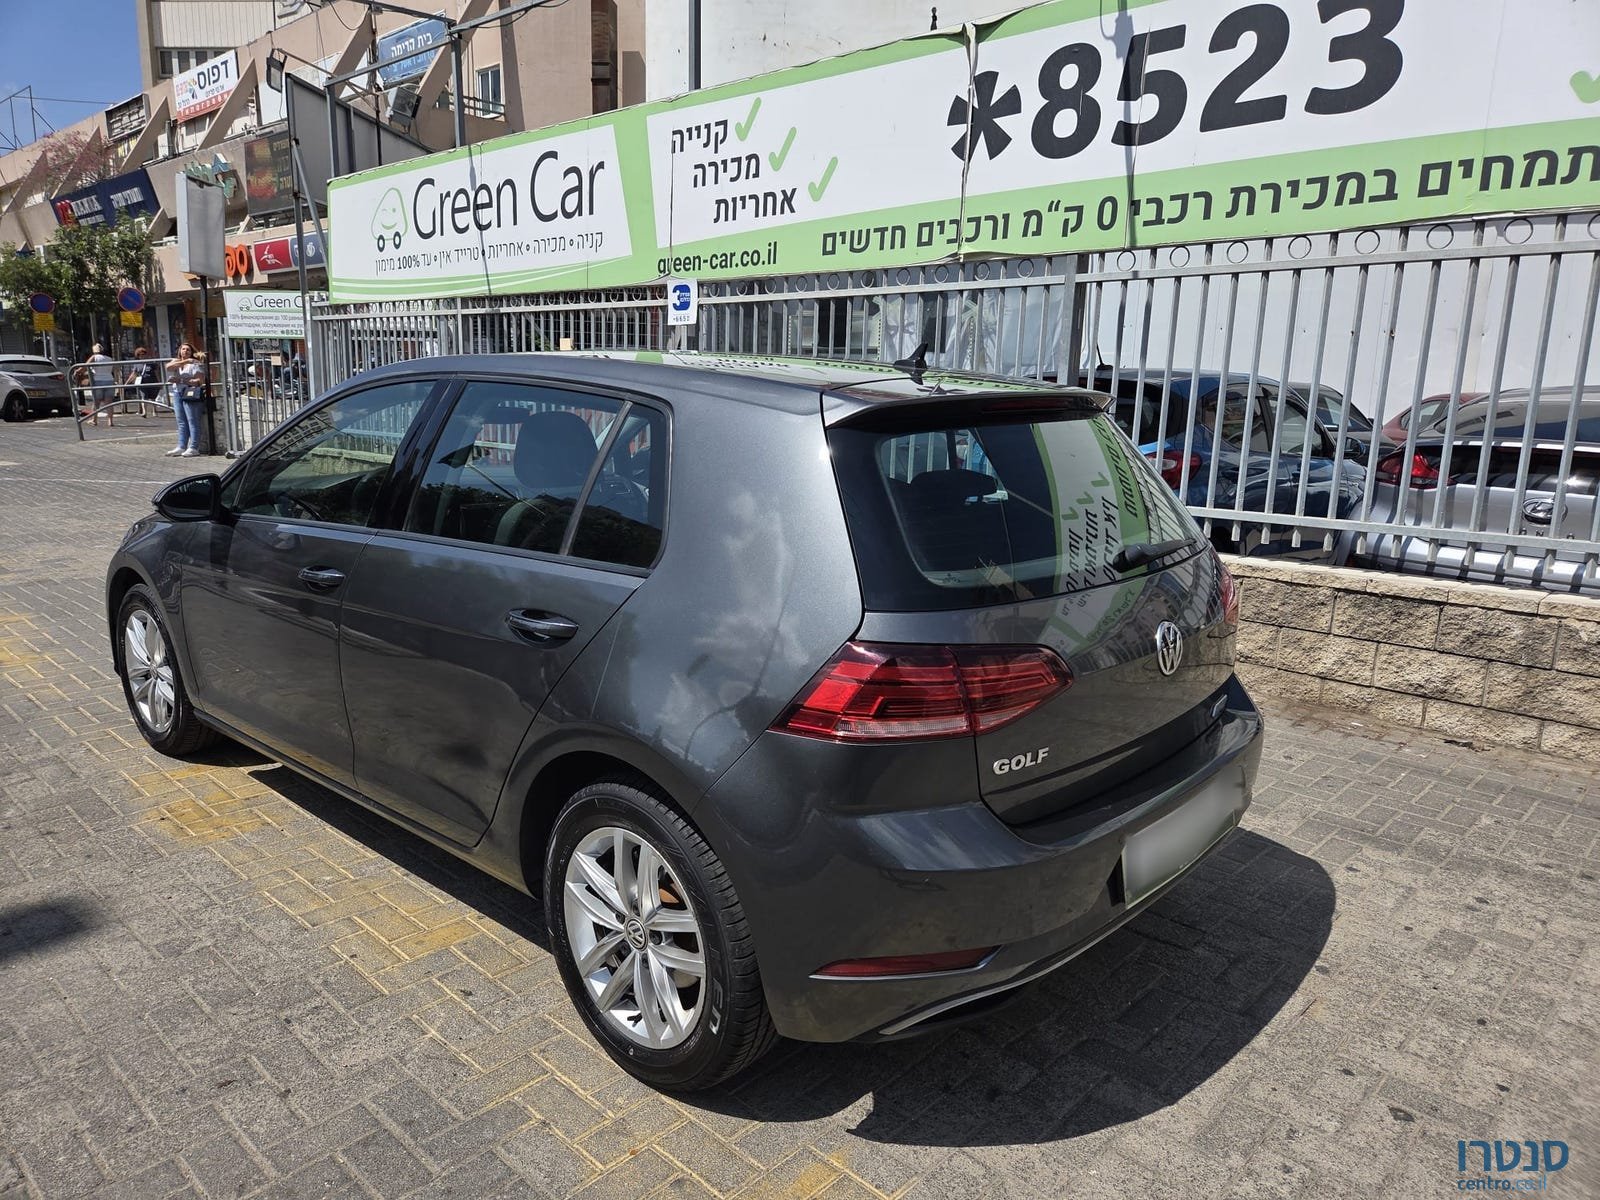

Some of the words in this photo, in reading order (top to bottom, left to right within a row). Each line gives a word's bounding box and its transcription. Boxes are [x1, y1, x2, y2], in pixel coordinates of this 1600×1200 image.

[197, 60, 229, 90] דפוס
[671, 119, 729, 154] קנייה
[693, 153, 761, 188] מכירה
[413, 177, 518, 240] Green
[529, 150, 605, 223] Car
[713, 187, 798, 224] אחריות
[1225, 168, 1399, 218] במכירת
[1096, 195, 1119, 231] 0
[1131, 190, 1213, 227] רכבי
[533, 235, 566, 254] מכירה
[577, 231, 604, 253] קניה
[821, 224, 907, 257] חדשים
[917, 213, 1010, 247] ורכבים
[397, 254, 420, 270] 100%
[420, 253, 432, 267] עד
[438, 250, 452, 269] אין
[454, 246, 480, 262] טרייד
[487, 240, 524, 259] אחריות
[657, 241, 778, 277] green-car.co.il
[375, 257, 396, 276] מימון
[254, 295, 291, 308] Green
[992, 746, 1050, 775] GOLF
